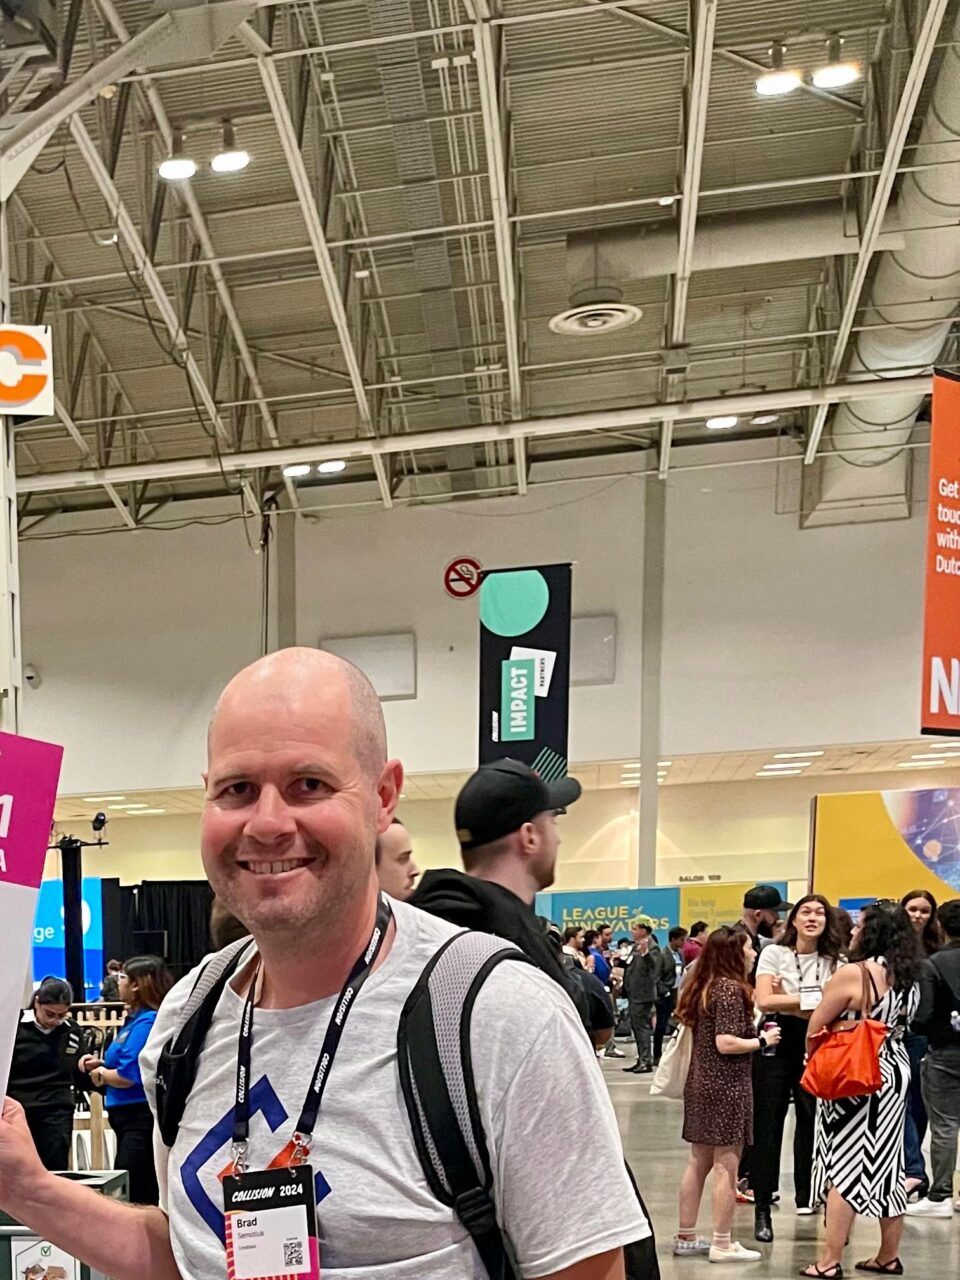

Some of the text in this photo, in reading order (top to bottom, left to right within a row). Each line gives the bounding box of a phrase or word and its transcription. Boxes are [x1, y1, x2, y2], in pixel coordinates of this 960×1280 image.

[938, 478, 959, 499] Get
[510, 667, 528, 733] IMPACT
[562, 906, 629, 921] LEAGUE
[562, 917, 670, 933] INNOVATRS
[364, 927, 381, 965] COLLISION
[334, 987, 354, 1026] COLLISION
[238, 1065, 246, 1103] COLLISION
[313, 1053, 330, 1094] COLLISION
[231, 1184, 303, 1203] COLLISION 2024
[236, 1217, 257, 1228] Brad
